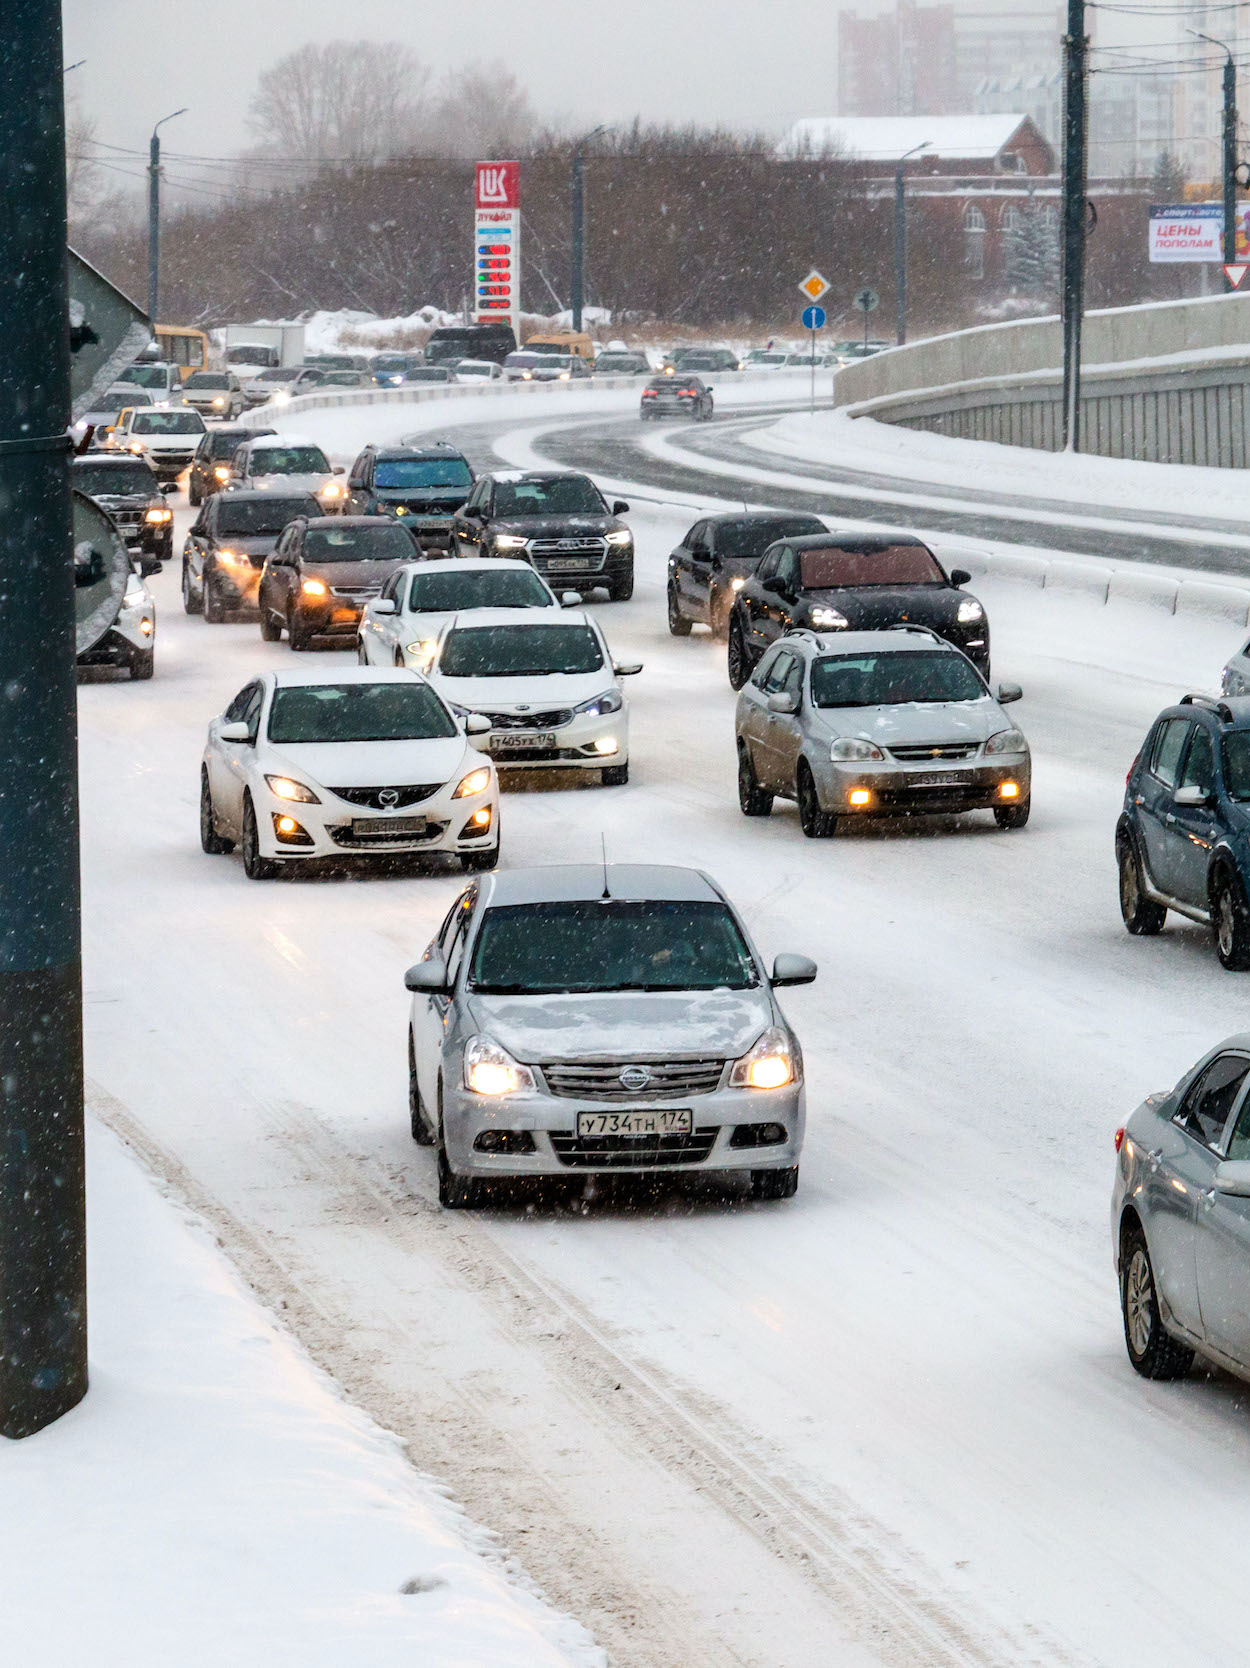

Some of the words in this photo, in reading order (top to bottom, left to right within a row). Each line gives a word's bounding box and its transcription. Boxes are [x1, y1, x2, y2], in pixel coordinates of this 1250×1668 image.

[1157, 224, 1202, 238] ЦЕНЫ
[1155, 239, 1213, 248] ПОПОЛАМ
[586, 1115, 655, 1133] У734ТН
[660, 1112, 686, 1126] 174
